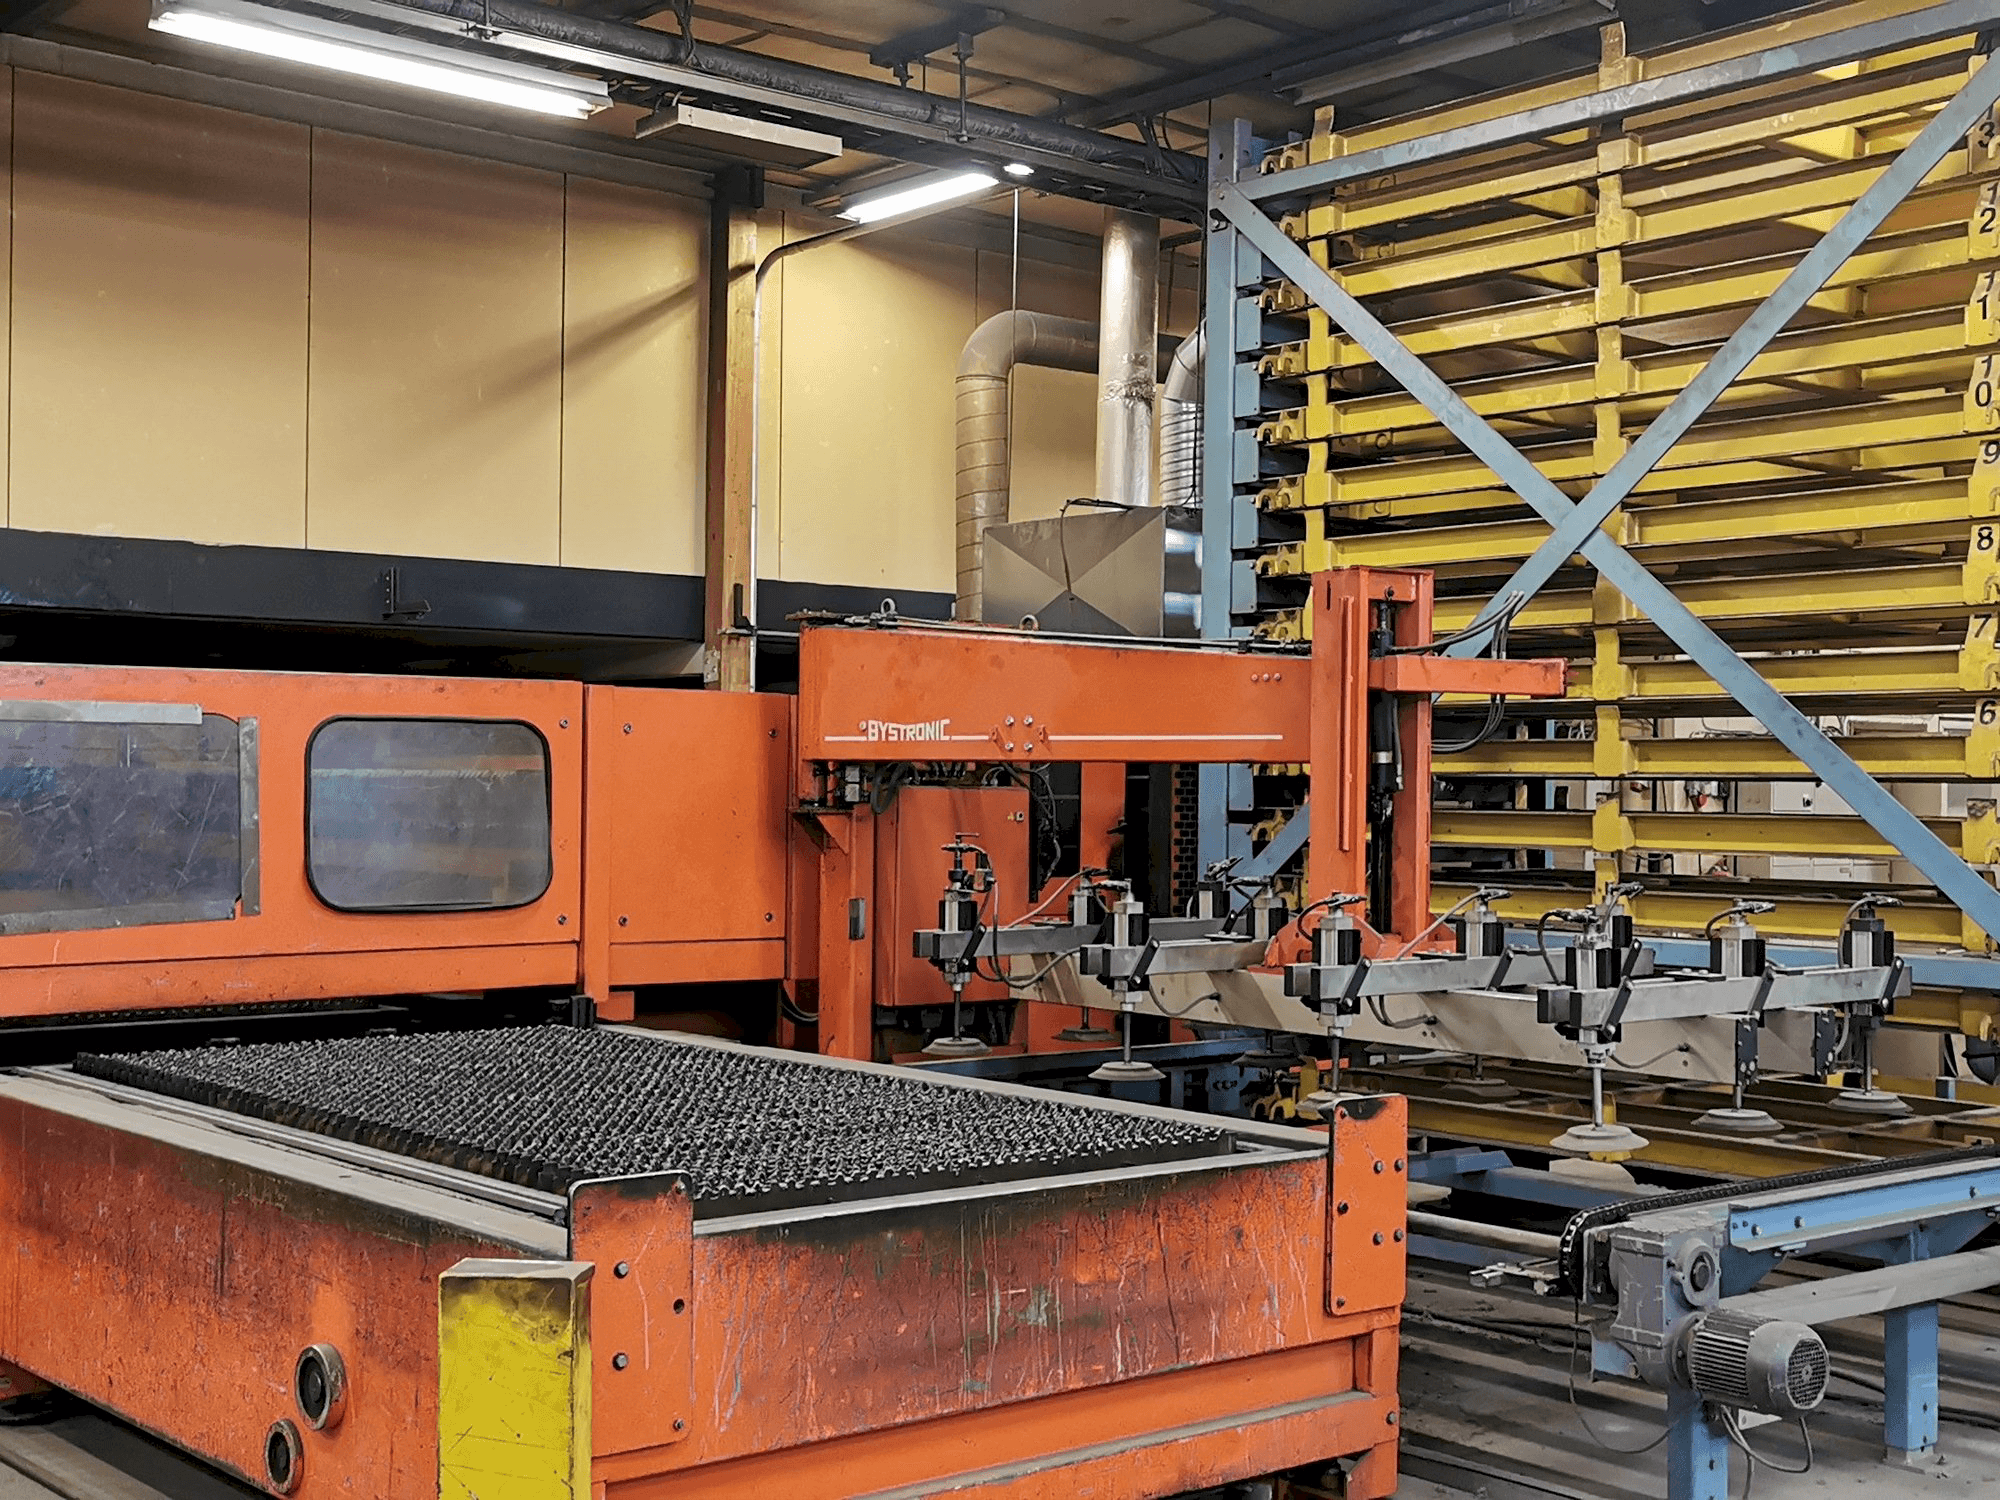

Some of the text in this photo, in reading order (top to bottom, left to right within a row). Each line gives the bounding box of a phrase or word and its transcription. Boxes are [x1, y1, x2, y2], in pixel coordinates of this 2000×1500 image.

[1982, 441, 2000, 464] 9
[1977, 526, 1993, 550] 8
[1974, 614, 1992, 638] 7
[1980, 700, 1996, 725] 6
[868, 719, 950, 741] BYSTRONIC
